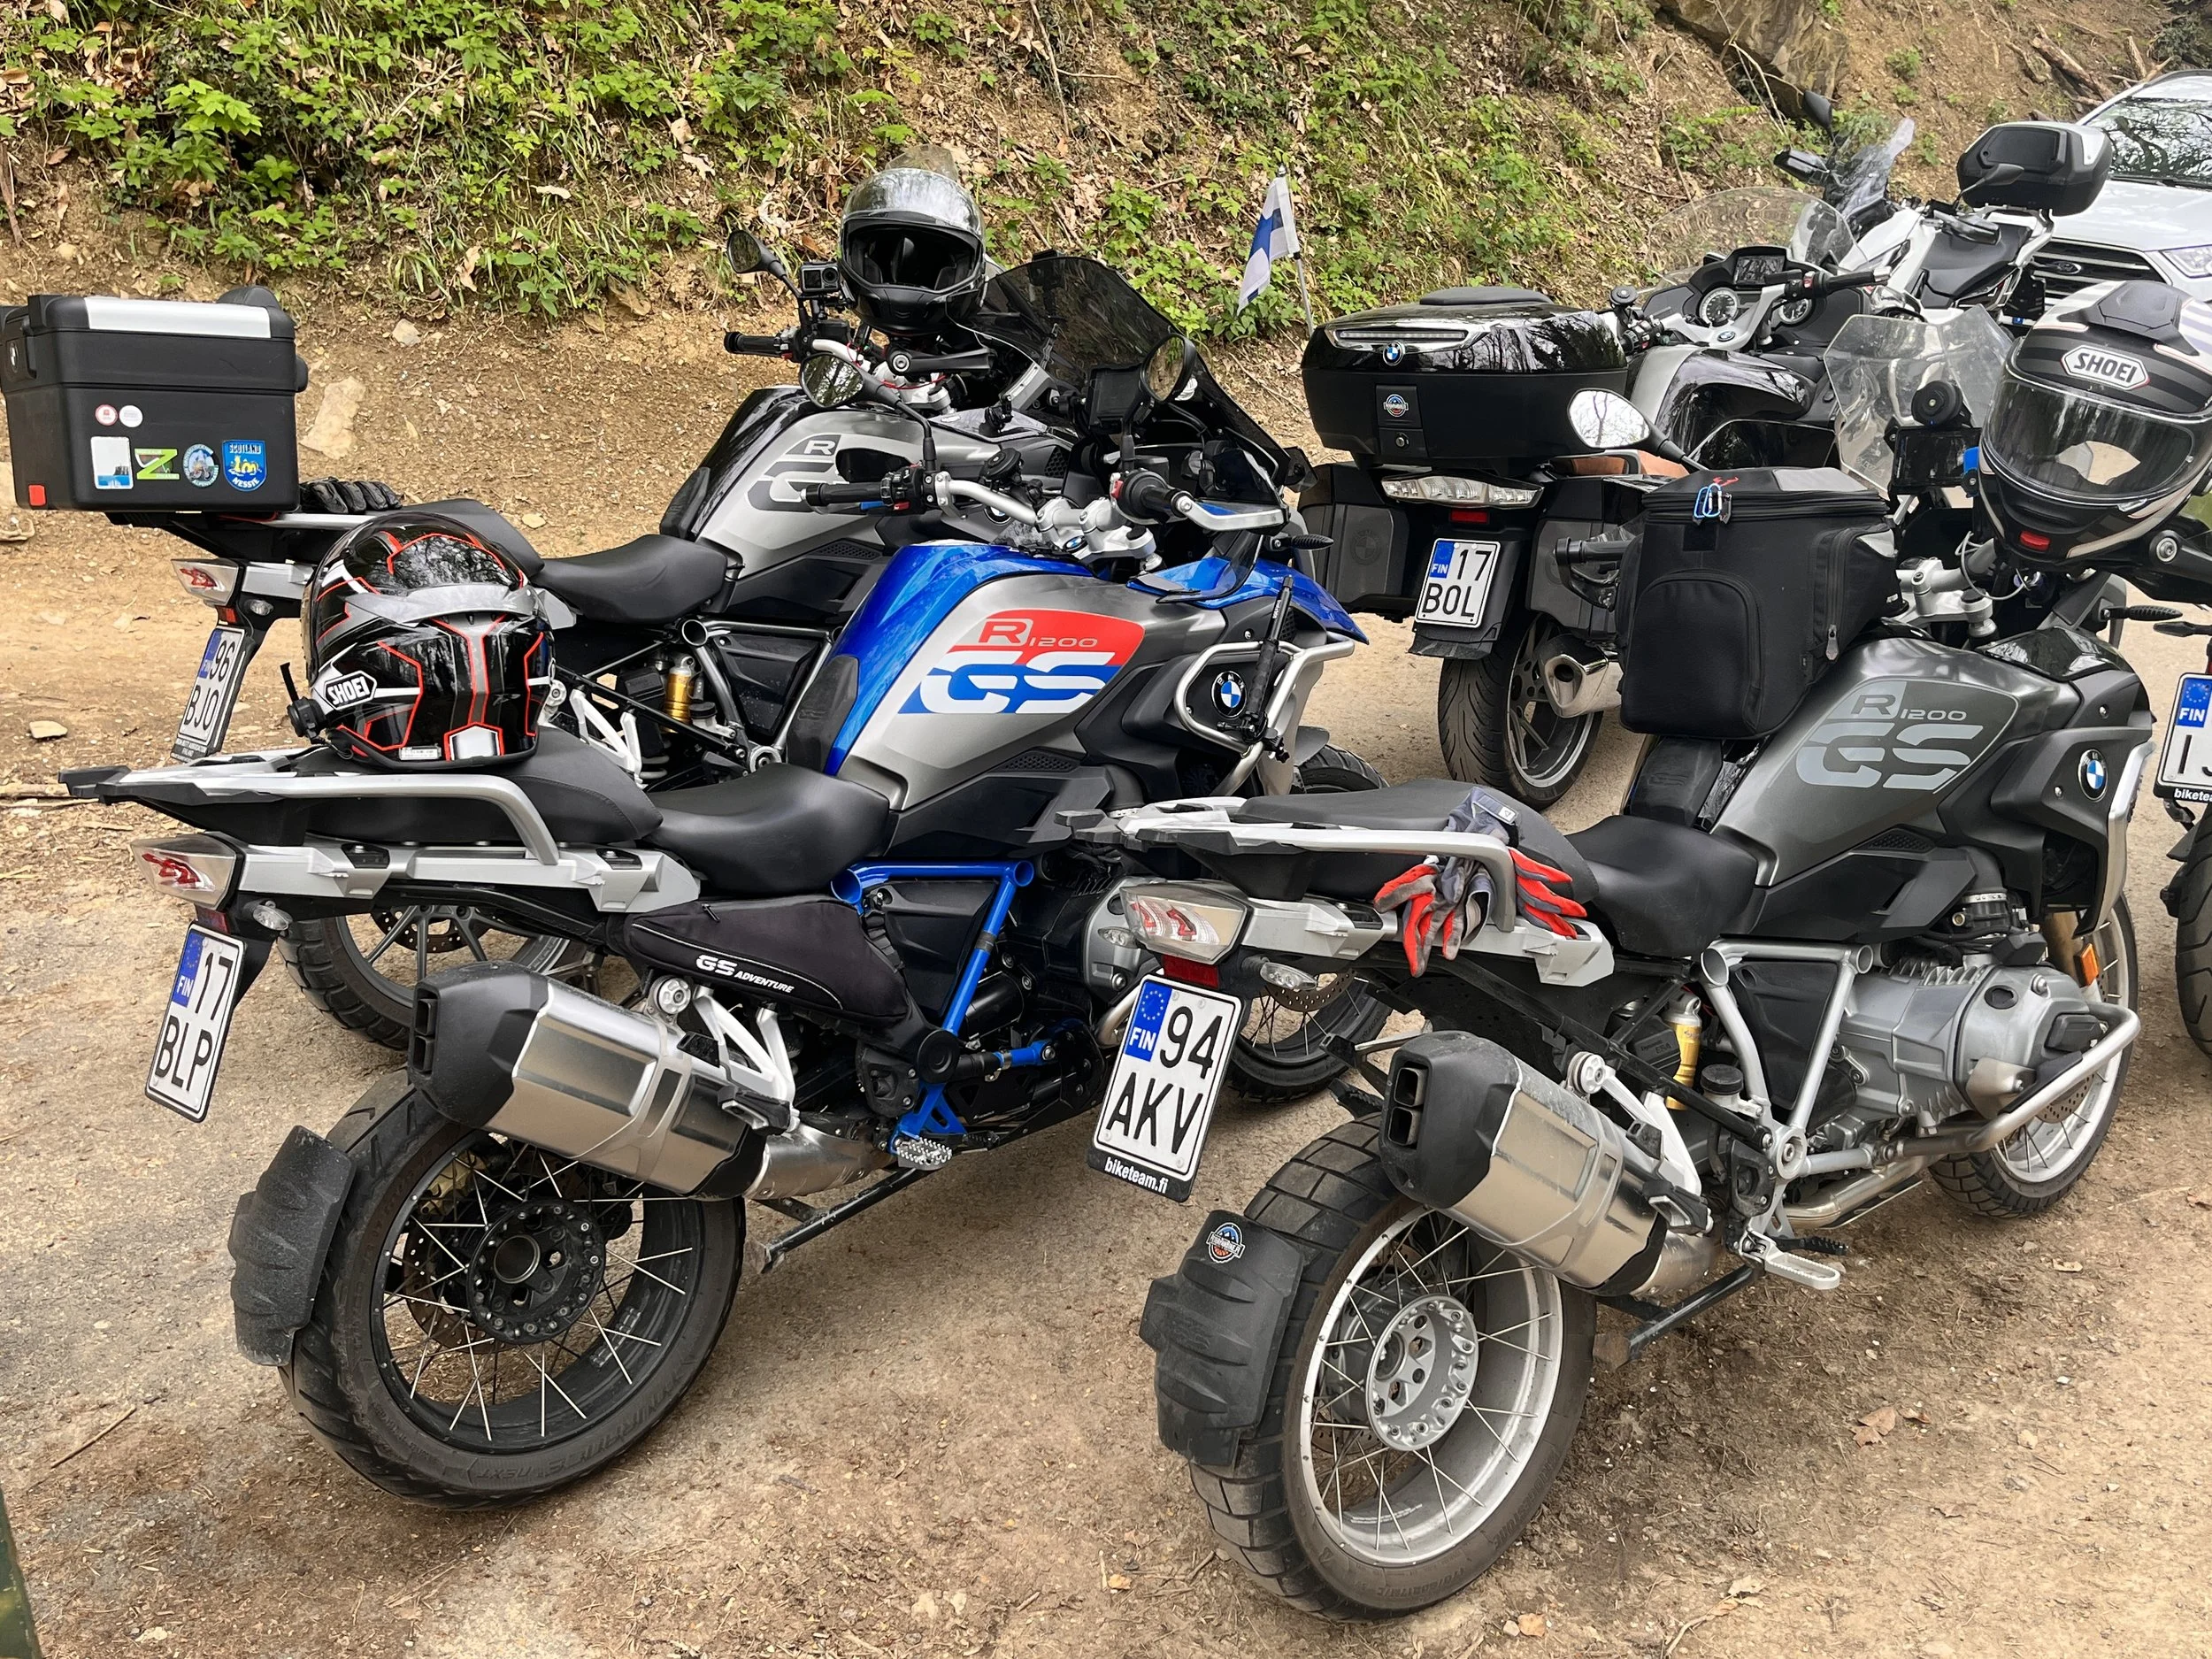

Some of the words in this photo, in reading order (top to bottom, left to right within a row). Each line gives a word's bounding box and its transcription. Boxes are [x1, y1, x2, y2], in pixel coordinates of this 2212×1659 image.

[2074, 352, 2138, 383] SHOEI
[232, 477, 260, 488] NESSIE
[1431, 564, 1448, 574] FIN
[1457, 549, 1493, 581] 17
[1421, 582, 1475, 618] BOL
[978, 621, 1027, 643] R
[1029, 637, 1098, 648] 1200
[210, 640, 235, 682] 96
[327, 677, 370, 704] SHOEI
[919, 650, 1116, 714] GS
[183, 684, 219, 731] BJO
[1851, 694, 1896, 715] R
[1900, 708, 1967, 721] 1200
[2178, 707, 2206, 722] FIN
[1795, 722, 1984, 791] GS
[177, 975, 195, 997] FIN
[195, 952, 234, 1021] 17
[695, 955, 738, 976] GS
[733, 971, 795, 993] ADVENTURE
[154, 1015, 213, 1092] BLP
[1129, 1026, 1156, 1051] FIN
[1159, 1005, 1224, 1079] 94
[1105, 1071, 1204, 1155] AKV
[1104, 1156, 1169, 1194] biketeam.fi
